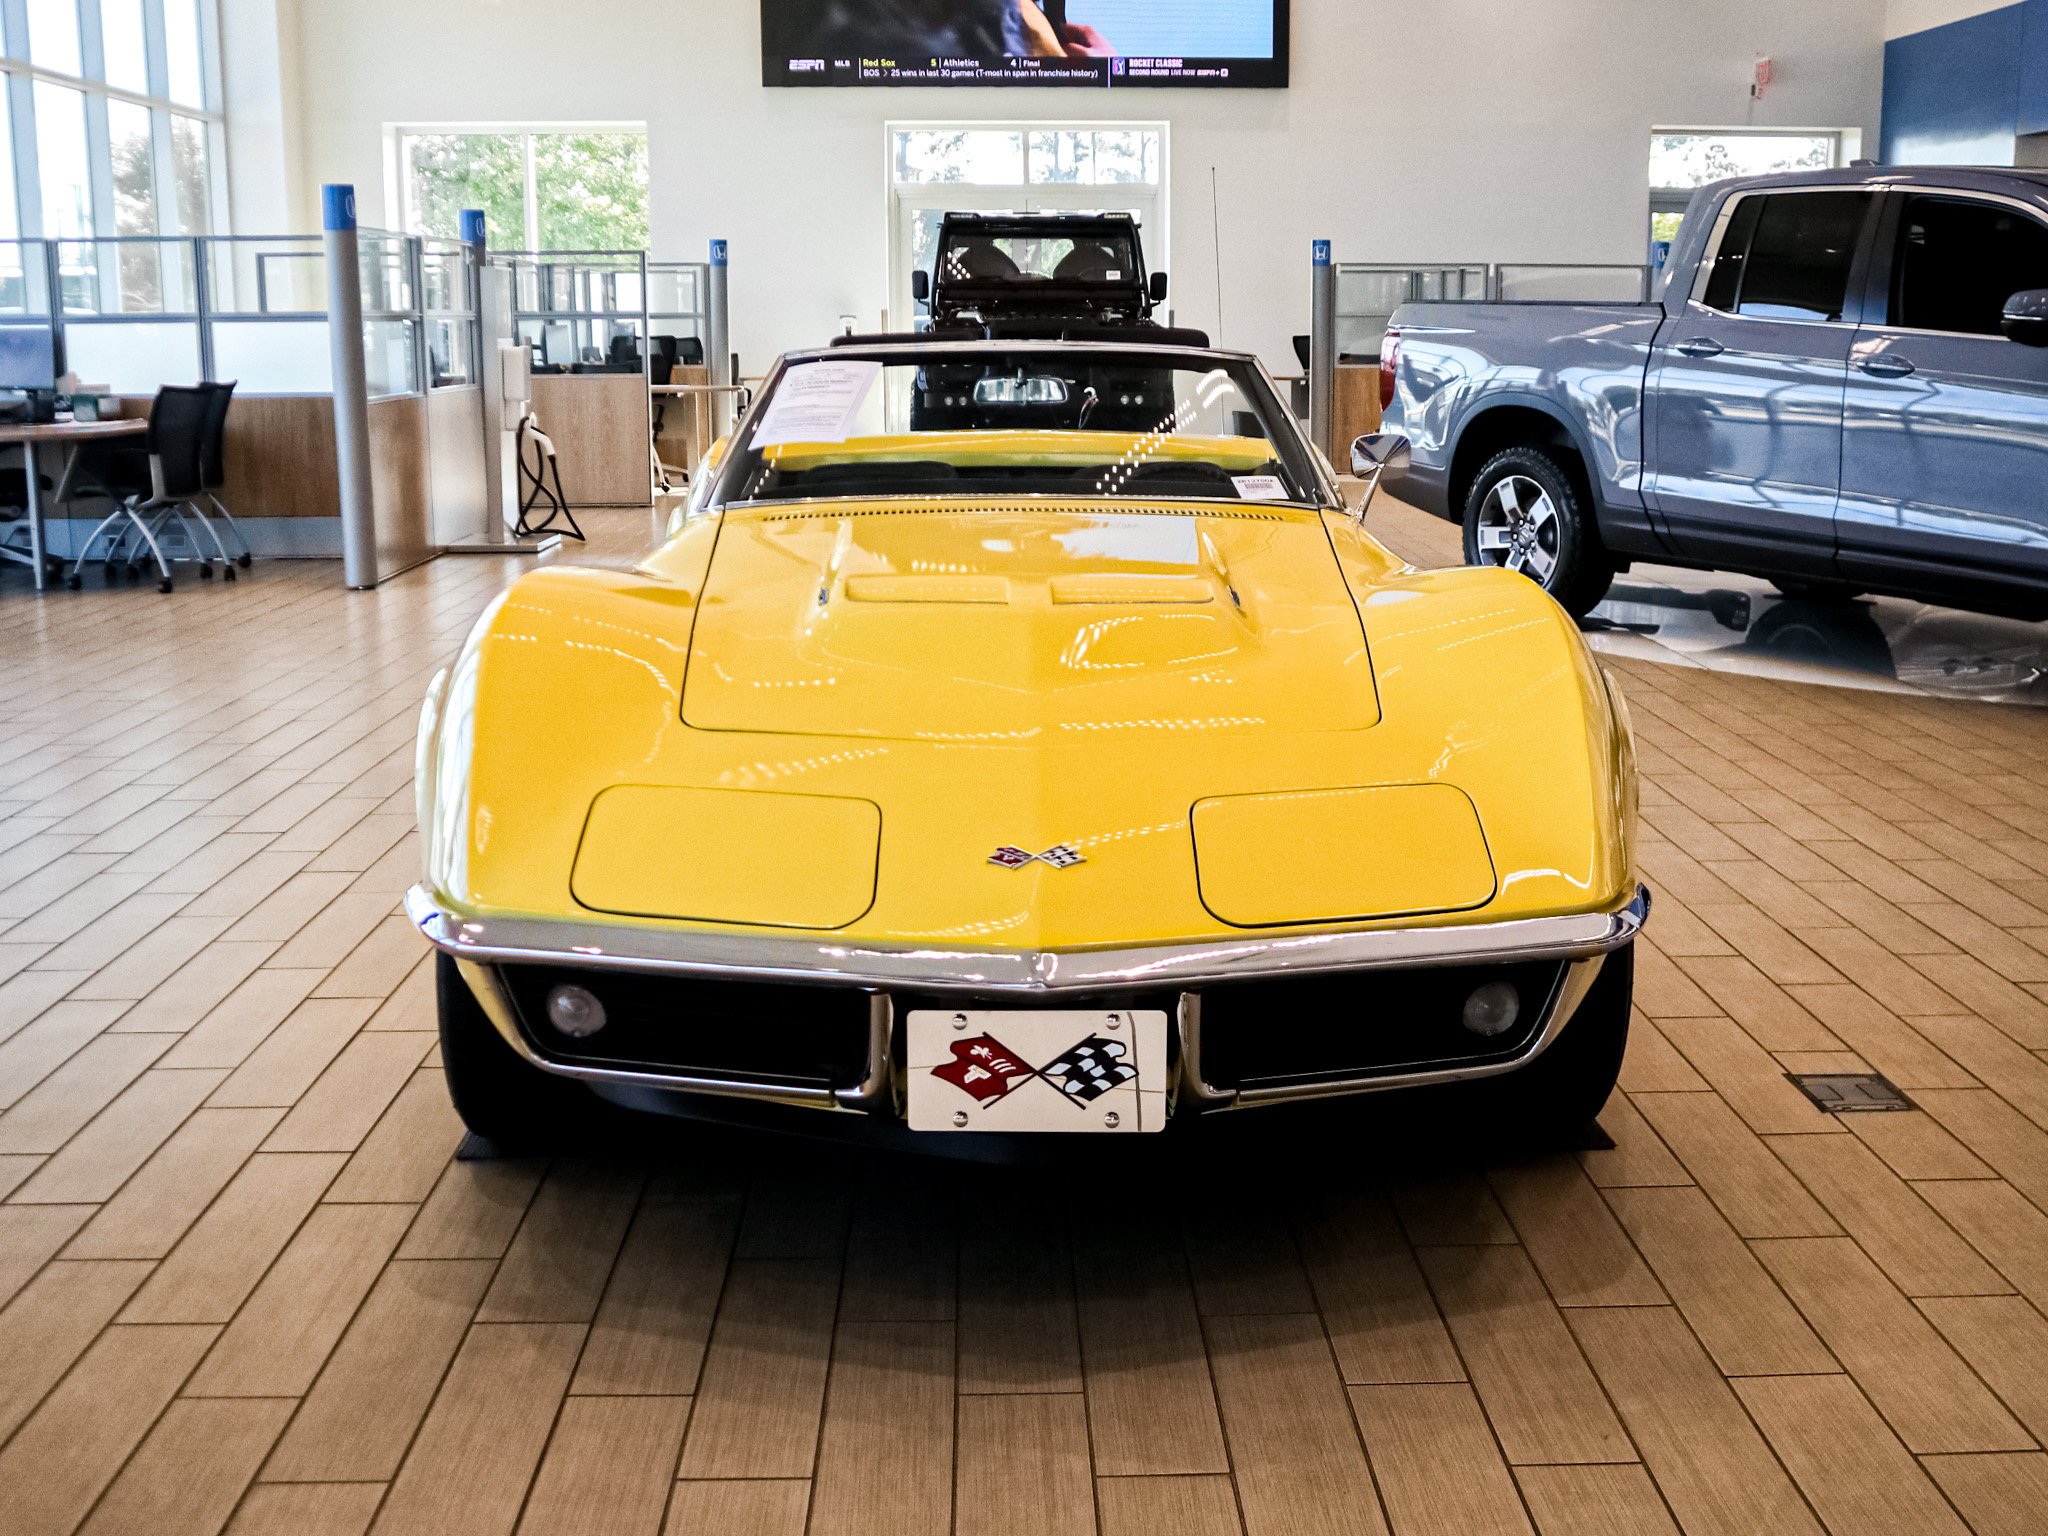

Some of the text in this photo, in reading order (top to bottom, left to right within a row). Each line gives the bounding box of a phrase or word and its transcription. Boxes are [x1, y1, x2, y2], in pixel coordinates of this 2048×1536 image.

[789, 59, 825, 70] ESPN
[834, 59, 850, 67] MLB
[863, 58, 937, 67] Red Sox 5
[943, 58, 1017, 67] Athletics 4
[1023, 59, 1040, 67] Final
[1129, 58, 1183, 68] ROCKET CLASSIC
[863, 69, 880, 77] BOS
[891, 69, 900, 77] 25
[901, 69, 918, 77] wins
[919, 69, 925, 77] in
[926, 69, 939, 77] last
[941, 69, 950, 77] 30
[951, 70, 975, 79] games
[1004, 69, 1011, 77] in
[1012, 70, 1029, 79] span
[1030, 69, 1037, 77] in
[1038, 69, 1070, 77] franchise
[1071, 69, 1099, 79] history)
